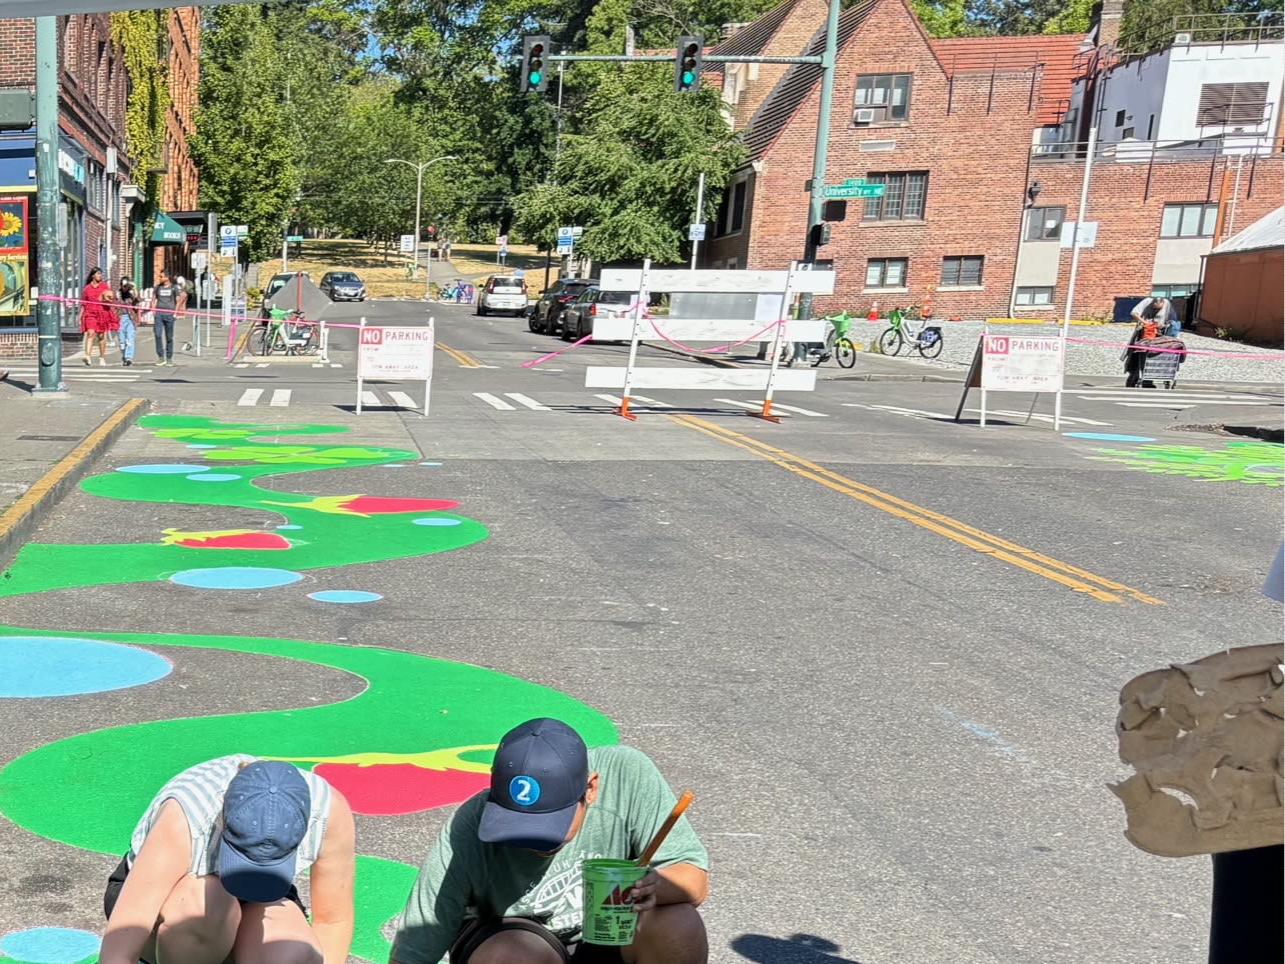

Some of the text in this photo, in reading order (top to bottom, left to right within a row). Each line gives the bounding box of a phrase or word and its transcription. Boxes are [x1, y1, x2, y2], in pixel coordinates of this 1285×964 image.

[824, 186, 863, 197] University
[363, 330, 429, 344] NO PARKING
[987, 339, 1059, 353] NO PARKING
[516, 779, 532, 802] 2
